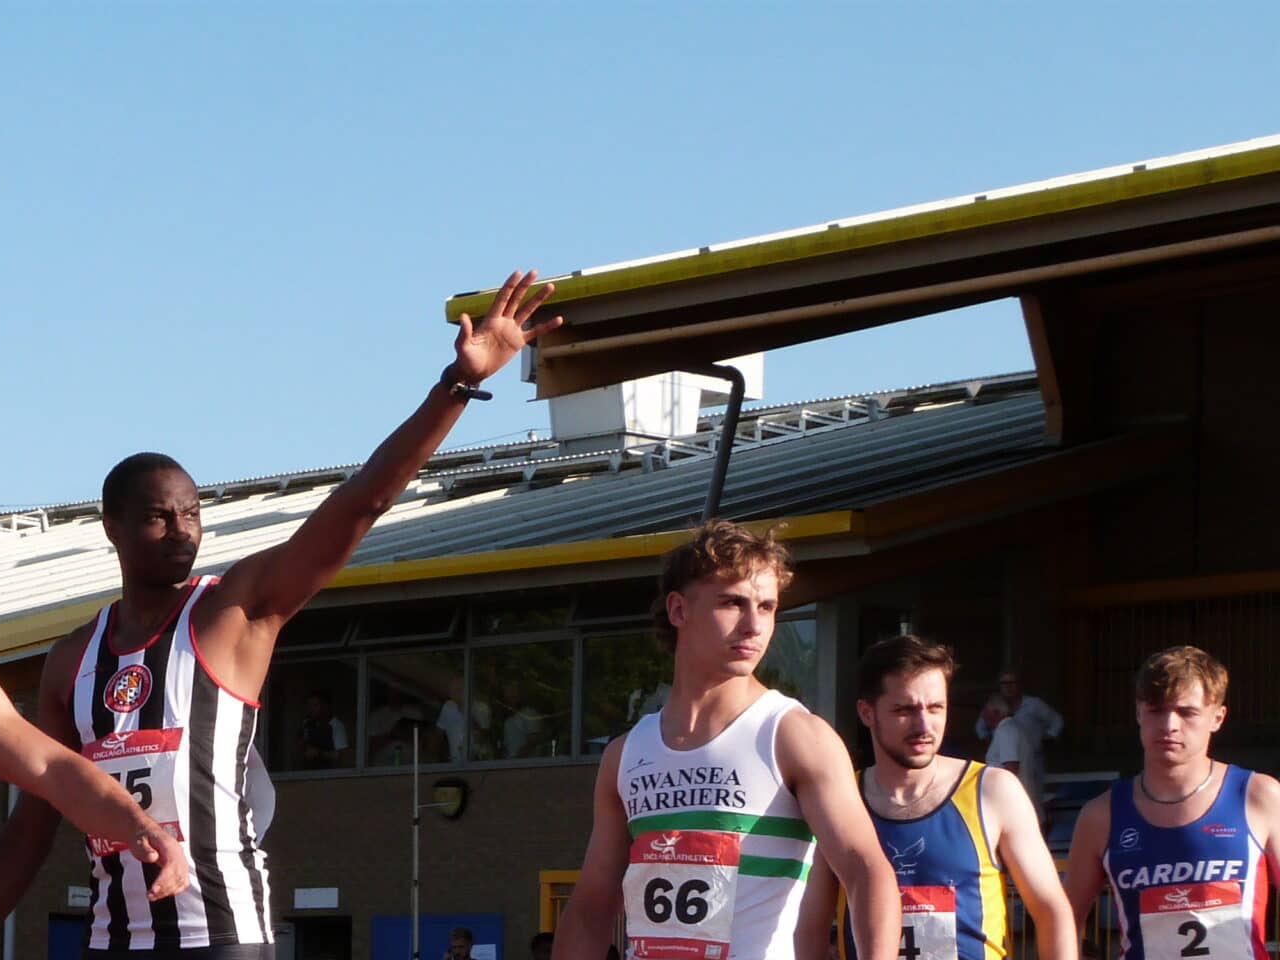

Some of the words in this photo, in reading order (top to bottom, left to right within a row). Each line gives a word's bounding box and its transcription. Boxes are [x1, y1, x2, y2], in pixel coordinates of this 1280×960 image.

[629, 767, 742, 796] SWANSEA
[627, 787, 747, 818] HARRIERS
[1117, 860, 1244, 889] CARDIFF
[643, 877, 711, 925] 66
[1177, 920, 1211, 958] 2
